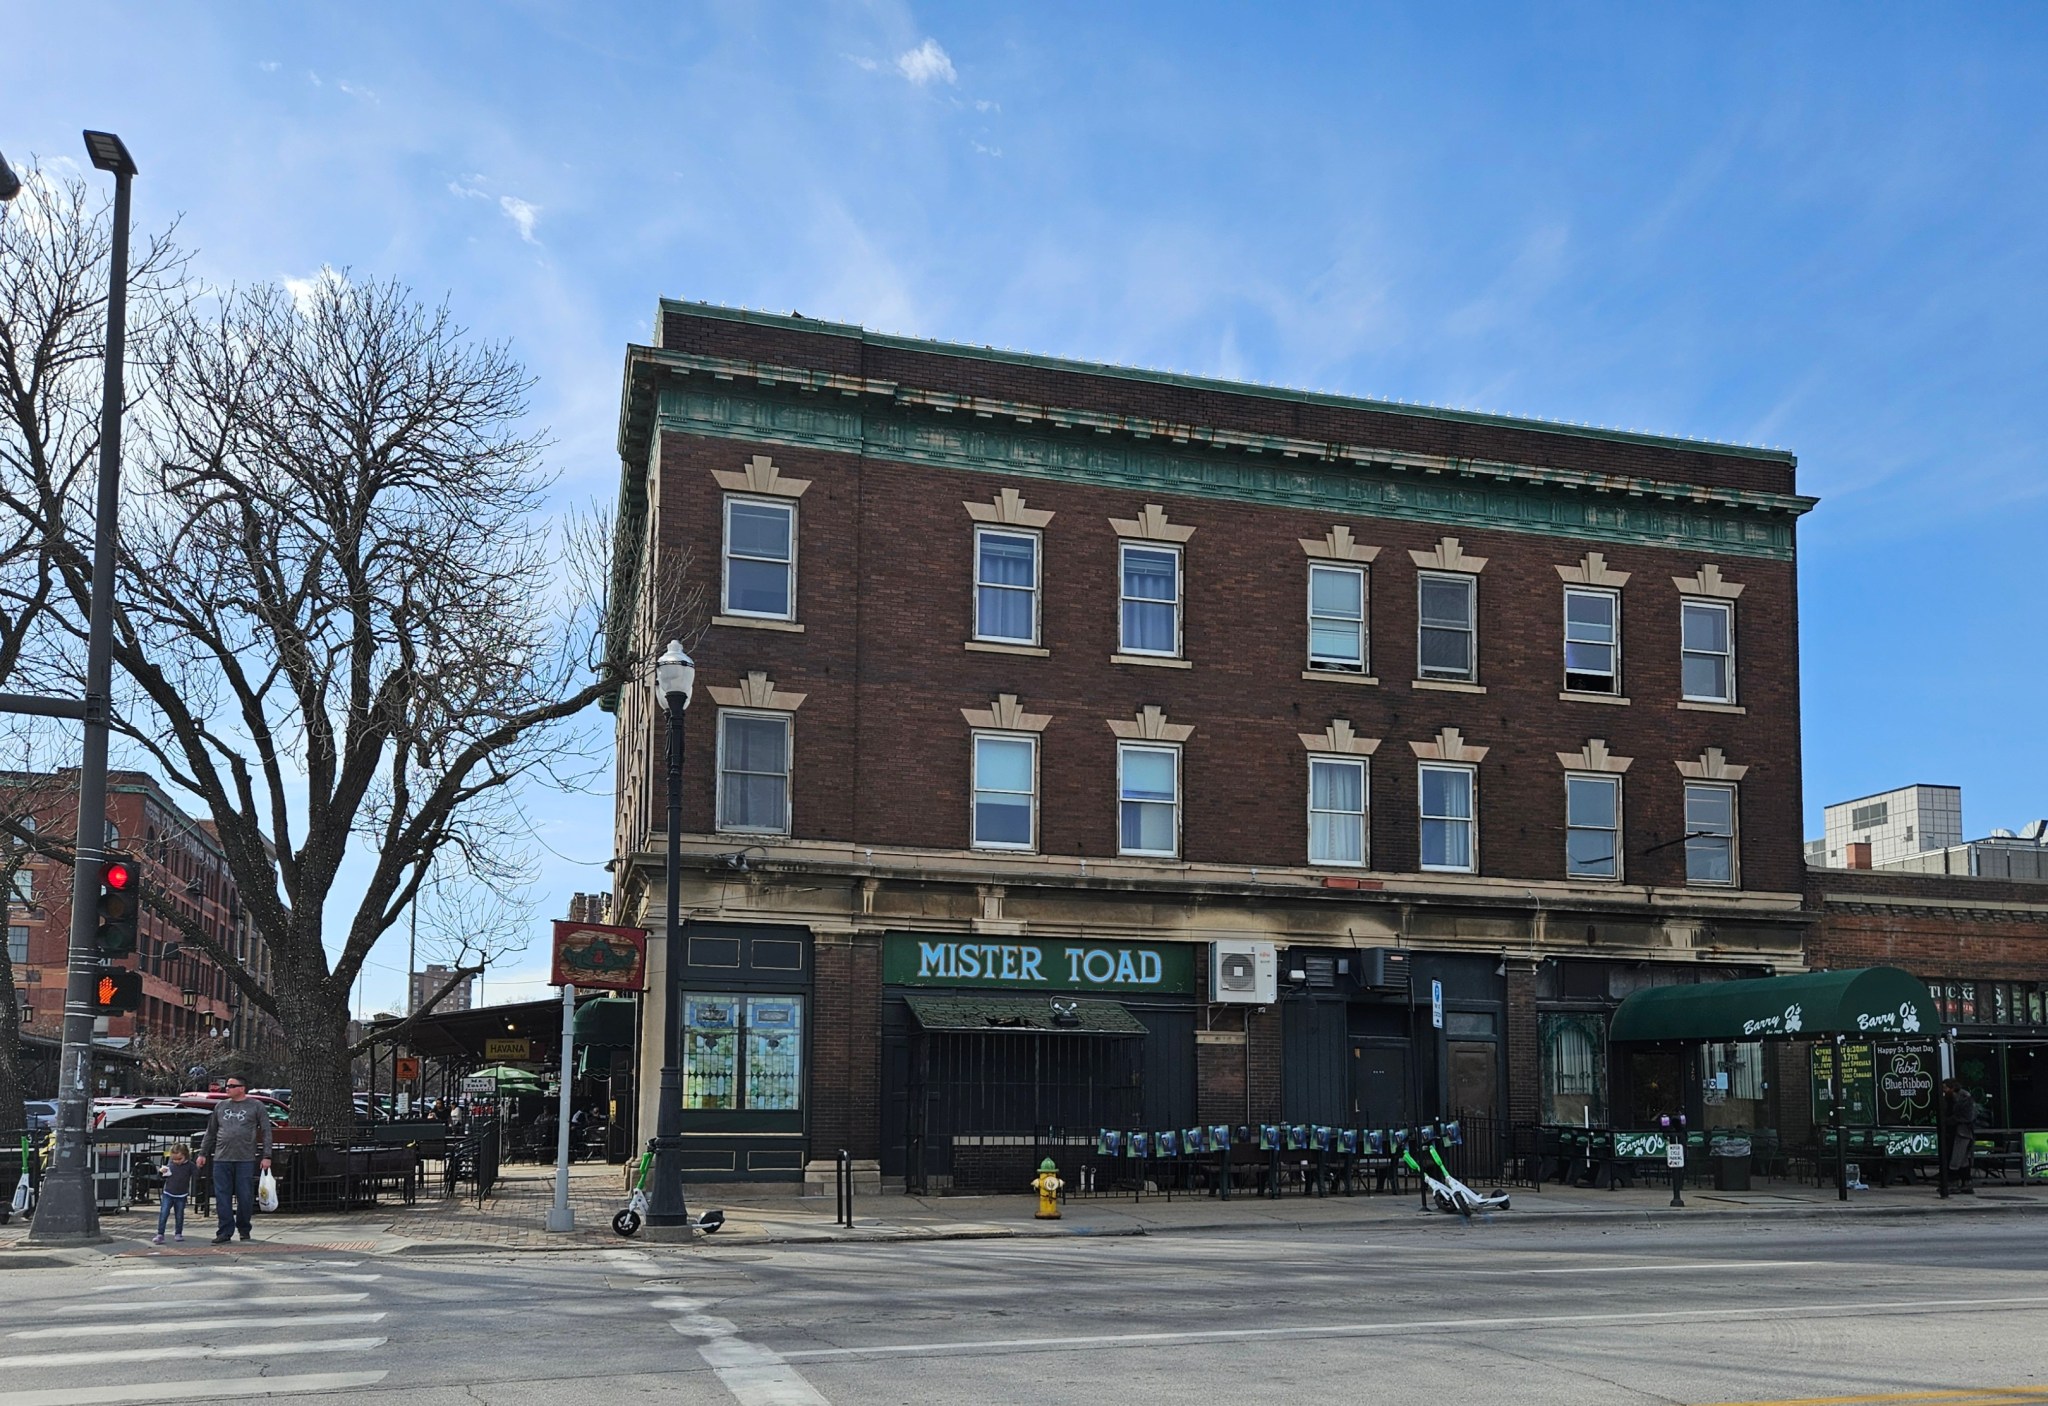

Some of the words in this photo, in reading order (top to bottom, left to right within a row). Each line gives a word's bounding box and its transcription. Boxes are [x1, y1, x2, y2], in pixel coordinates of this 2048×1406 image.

[917, 941, 1048, 981] MISTER
[1064, 947, 1162, 984] TOAD
[1743, 1015, 1780, 1035] Barry
[1784, 1003, 1802, 1020] O's
[1857, 1011, 1896, 1030] Barry
[1899, 1001, 1918, 1018] O's
[490, 1043, 525, 1054] HAVANA
[1877, 1046, 1897, 1054] Happy
[1905, 1045, 1922, 1053] Pabst
[1922, 1045, 1934, 1053] Day
[1894, 1057, 1918, 1074] Pabst
[1885, 1077, 1902, 1089] Blue
[1902, 1077, 1931, 1089] Ribbon
[1616, 1136, 1646, 1155] Barry
[1645, 1133, 1665, 1154] O's
[1886, 1136, 1913, 1155] Barry
[1912, 1133, 1930, 1153] O's
